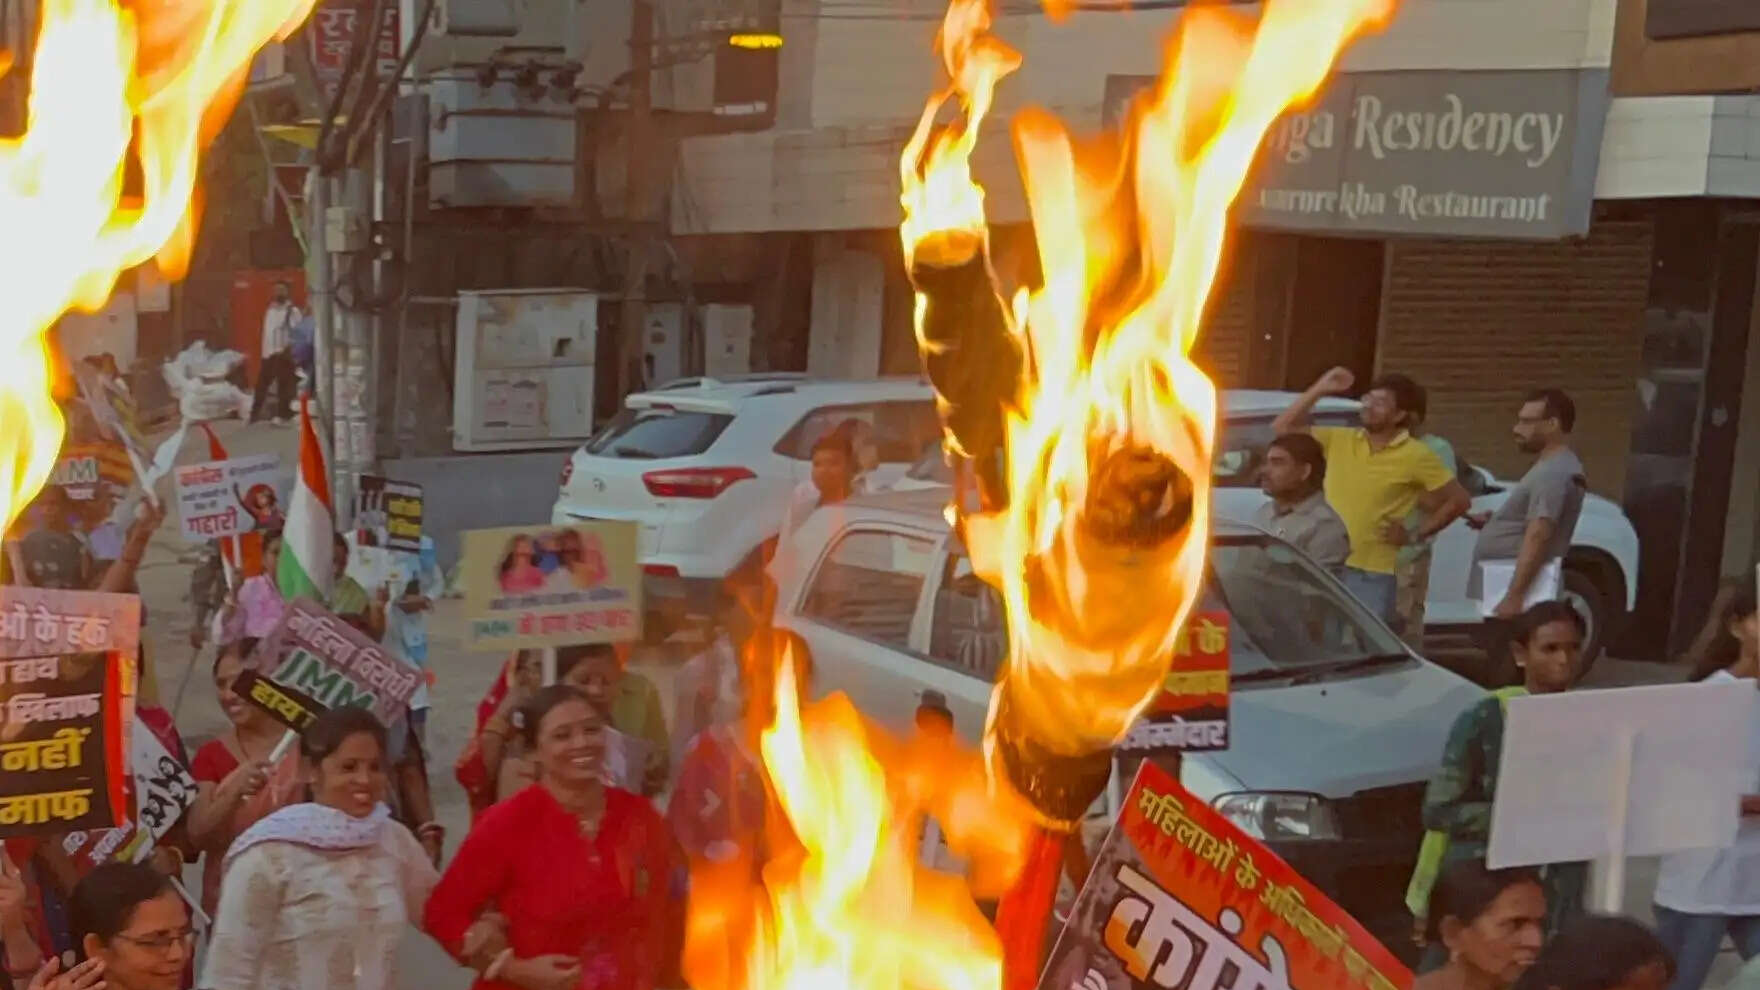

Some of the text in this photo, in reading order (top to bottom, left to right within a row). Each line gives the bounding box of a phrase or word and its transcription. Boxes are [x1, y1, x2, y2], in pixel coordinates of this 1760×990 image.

[1353, 93, 1564, 167] Residency
[1393, 183, 1552, 221] Restaurant
[32, 605, 61, 642] के
[271, 646, 378, 711] JMM
[1138, 787, 1239, 874] महिलाओं
[1234, 854, 1260, 890] के
